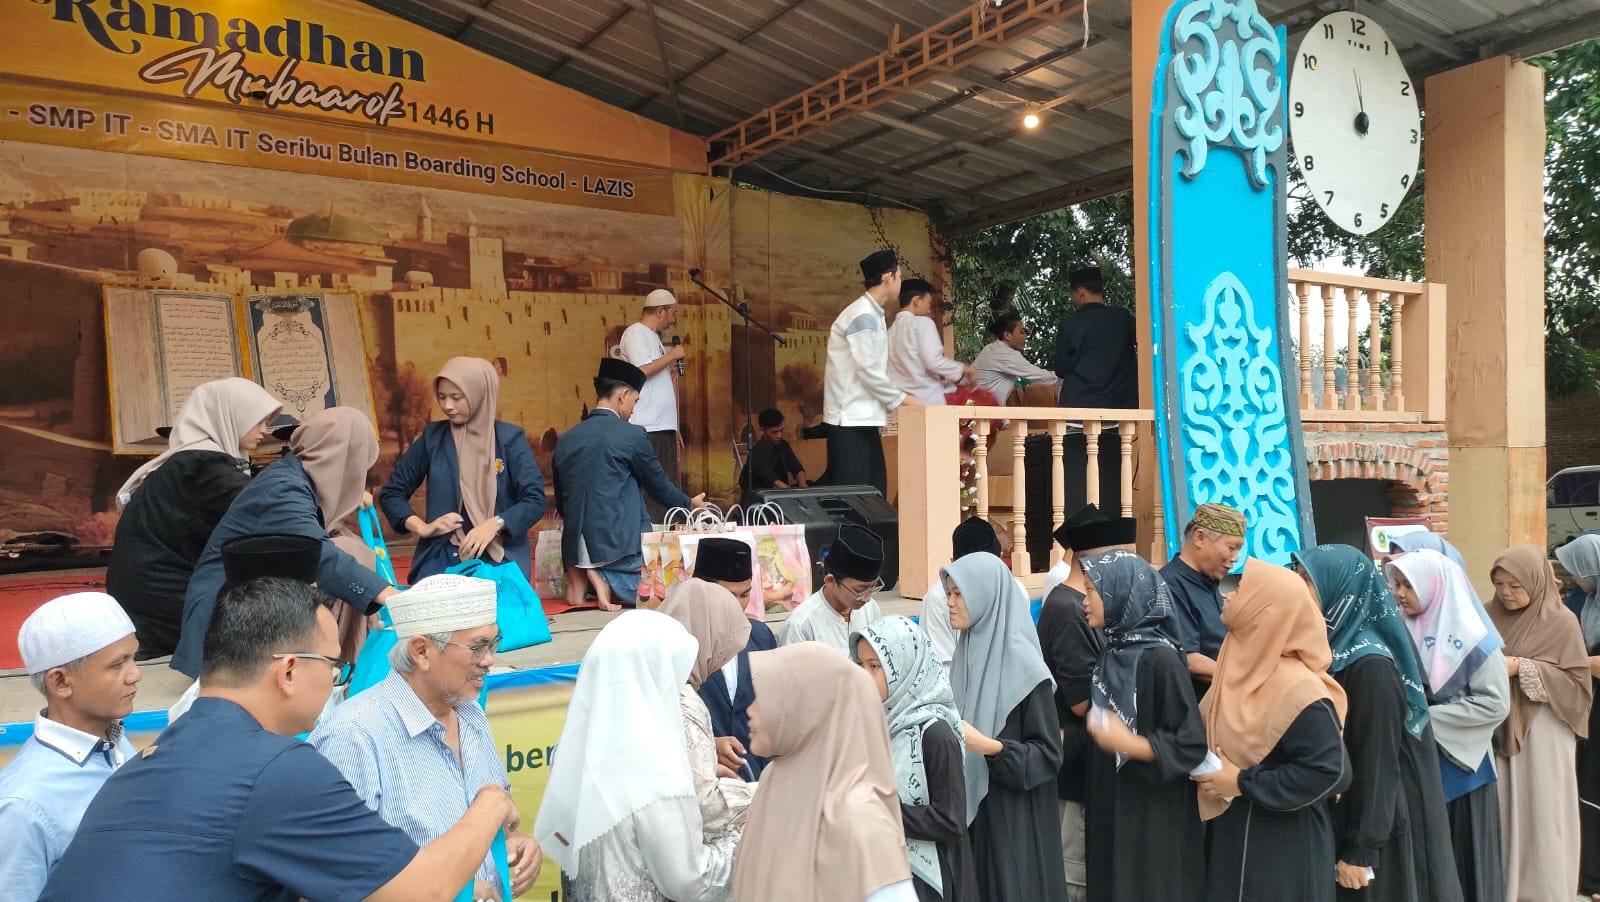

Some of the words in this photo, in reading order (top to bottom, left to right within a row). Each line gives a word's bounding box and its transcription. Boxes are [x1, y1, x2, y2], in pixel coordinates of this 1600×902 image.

[1323, 23, 1335, 40] 11
[1350, 17, 1366, 36] 12
[1383, 40, 1389, 56] 1
[1400, 81, 1410, 97] 2
[1294, 101, 1305, 118] 9
[407, 101, 470, 131] 1446
[476, 112, 495, 136] H
[1410, 128, 1418, 145] 3
[28, 103, 96, 131] SMP
[104, 112, 132, 135] IT
[157, 120, 219, 148] SMA
[226, 128, 250, 150] IT
[257, 132, 331, 161] Seribu
[338, 143, 398, 169] Bulan
[404, 151, 496, 185] Boarding
[501, 164, 566, 190] School
[583, 175, 635, 198] LAZIS
[1303, 155, 1315, 171] 8
[1324, 190, 1334, 206] 7
[1379, 203, 1389, 219] 5
[1353, 213, 1362, 228] 6
